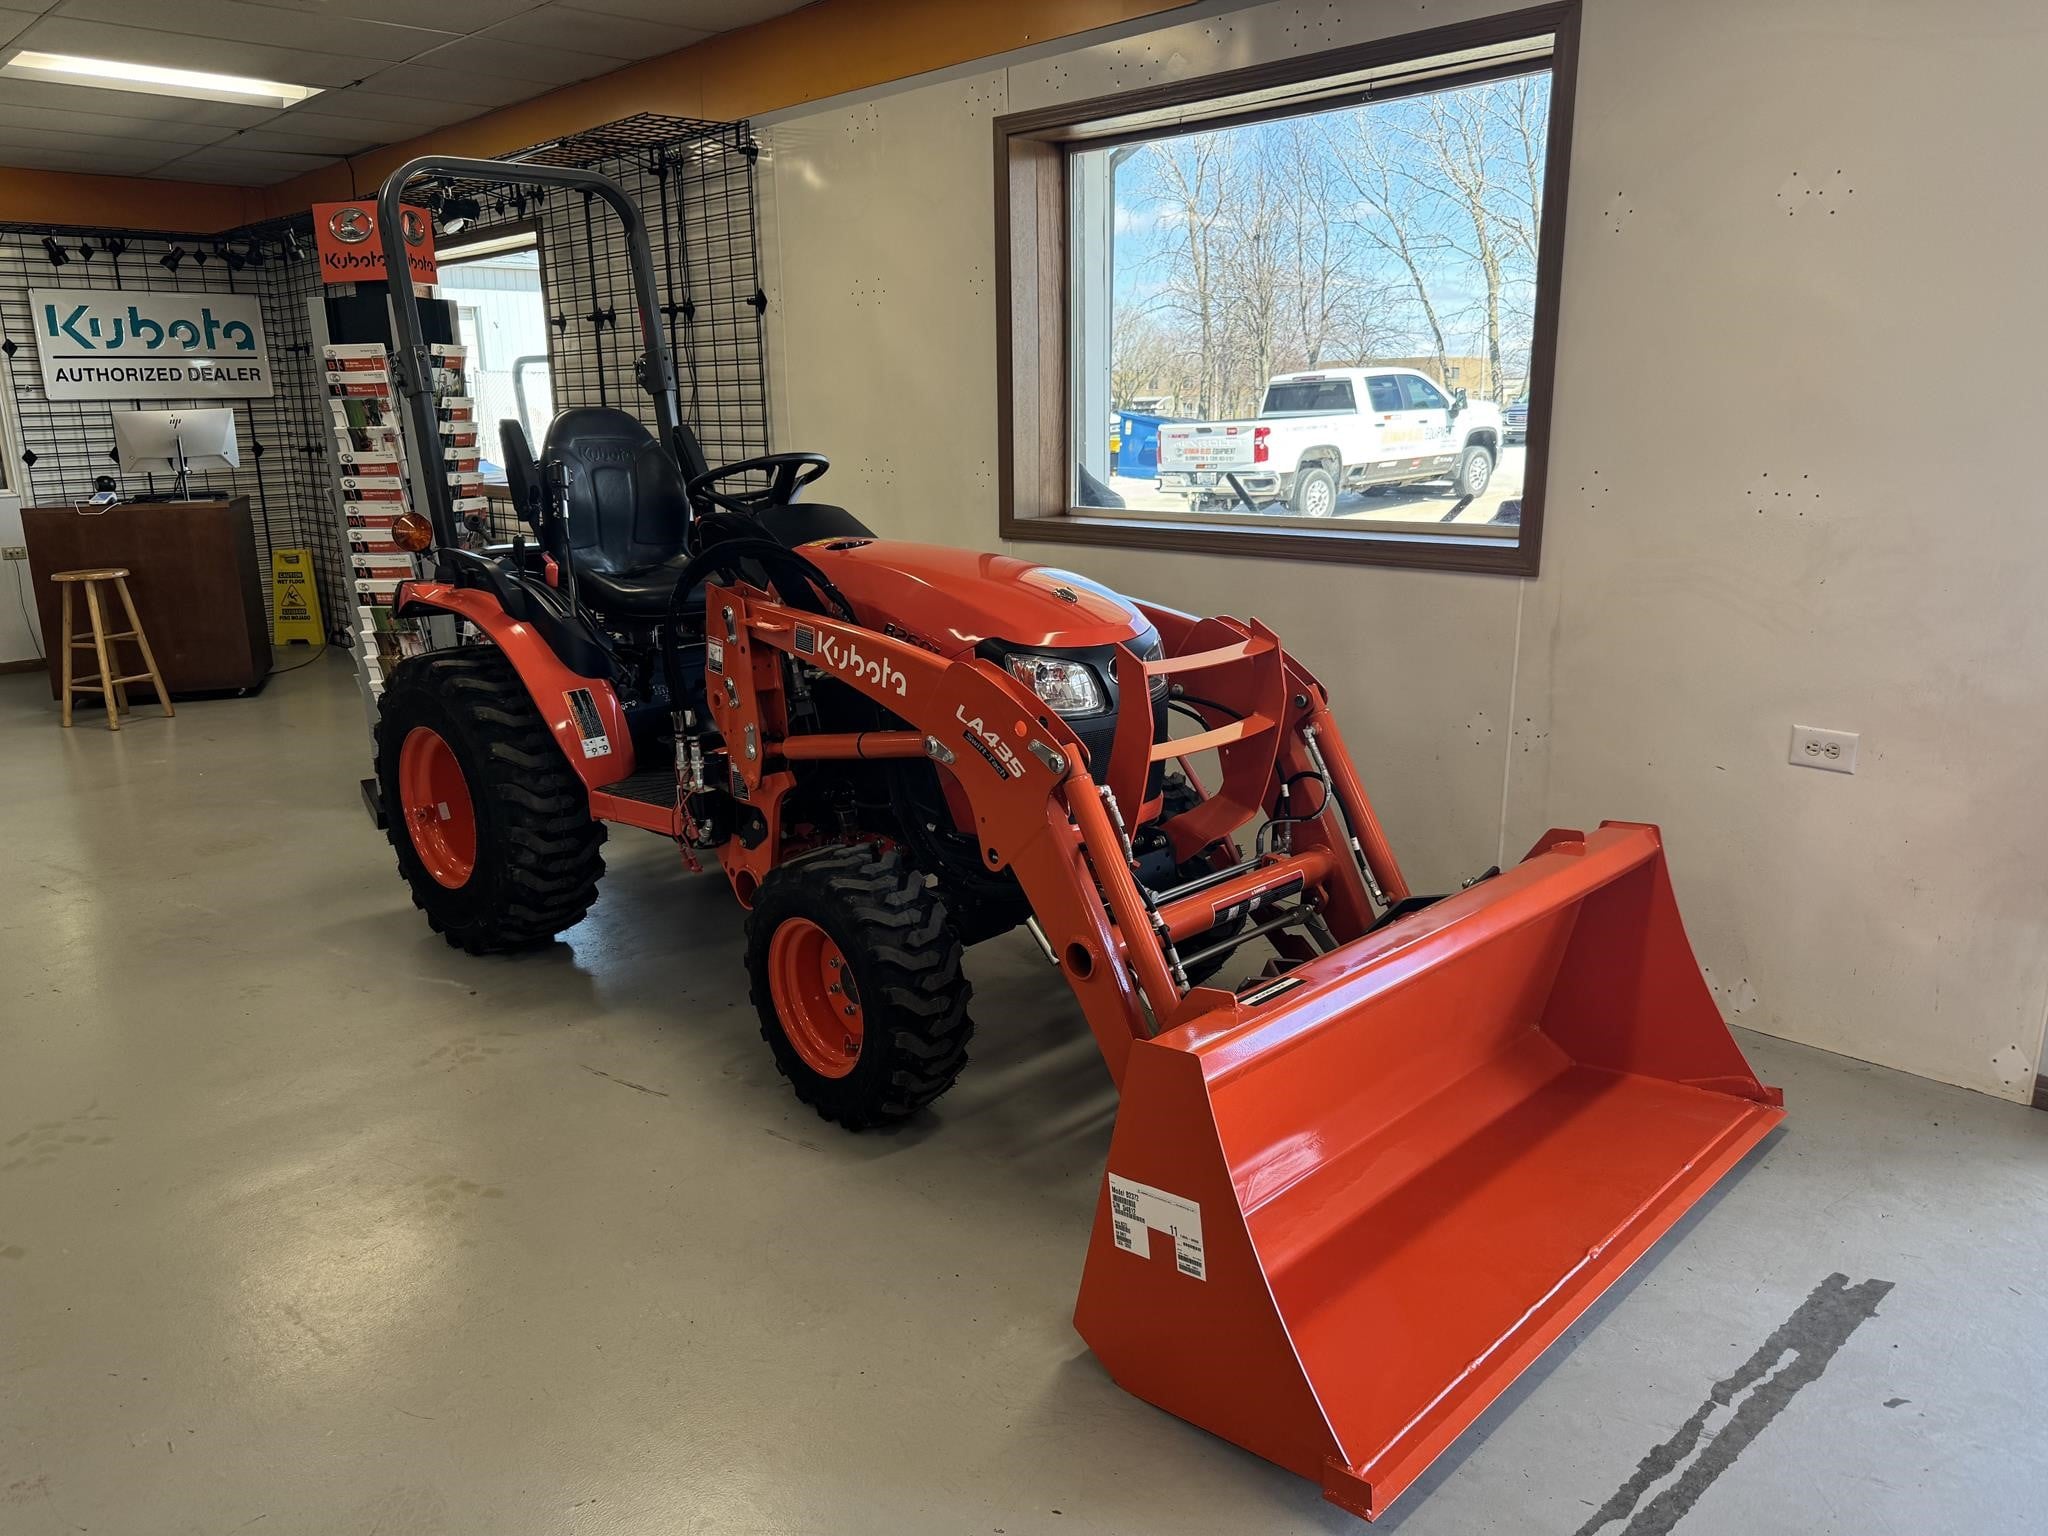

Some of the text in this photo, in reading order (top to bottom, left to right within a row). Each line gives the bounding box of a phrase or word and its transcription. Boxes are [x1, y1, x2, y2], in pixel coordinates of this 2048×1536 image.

[44, 303, 256, 351] Kubota
[55, 367, 261, 383] AUTHORIZED DEALER
[169, 413, 182, 429] hp
[818, 631, 907, 697] Kubota
[955, 704, 1026, 778] LA435
[964, 732, 1006, 778] Swift-Tach
